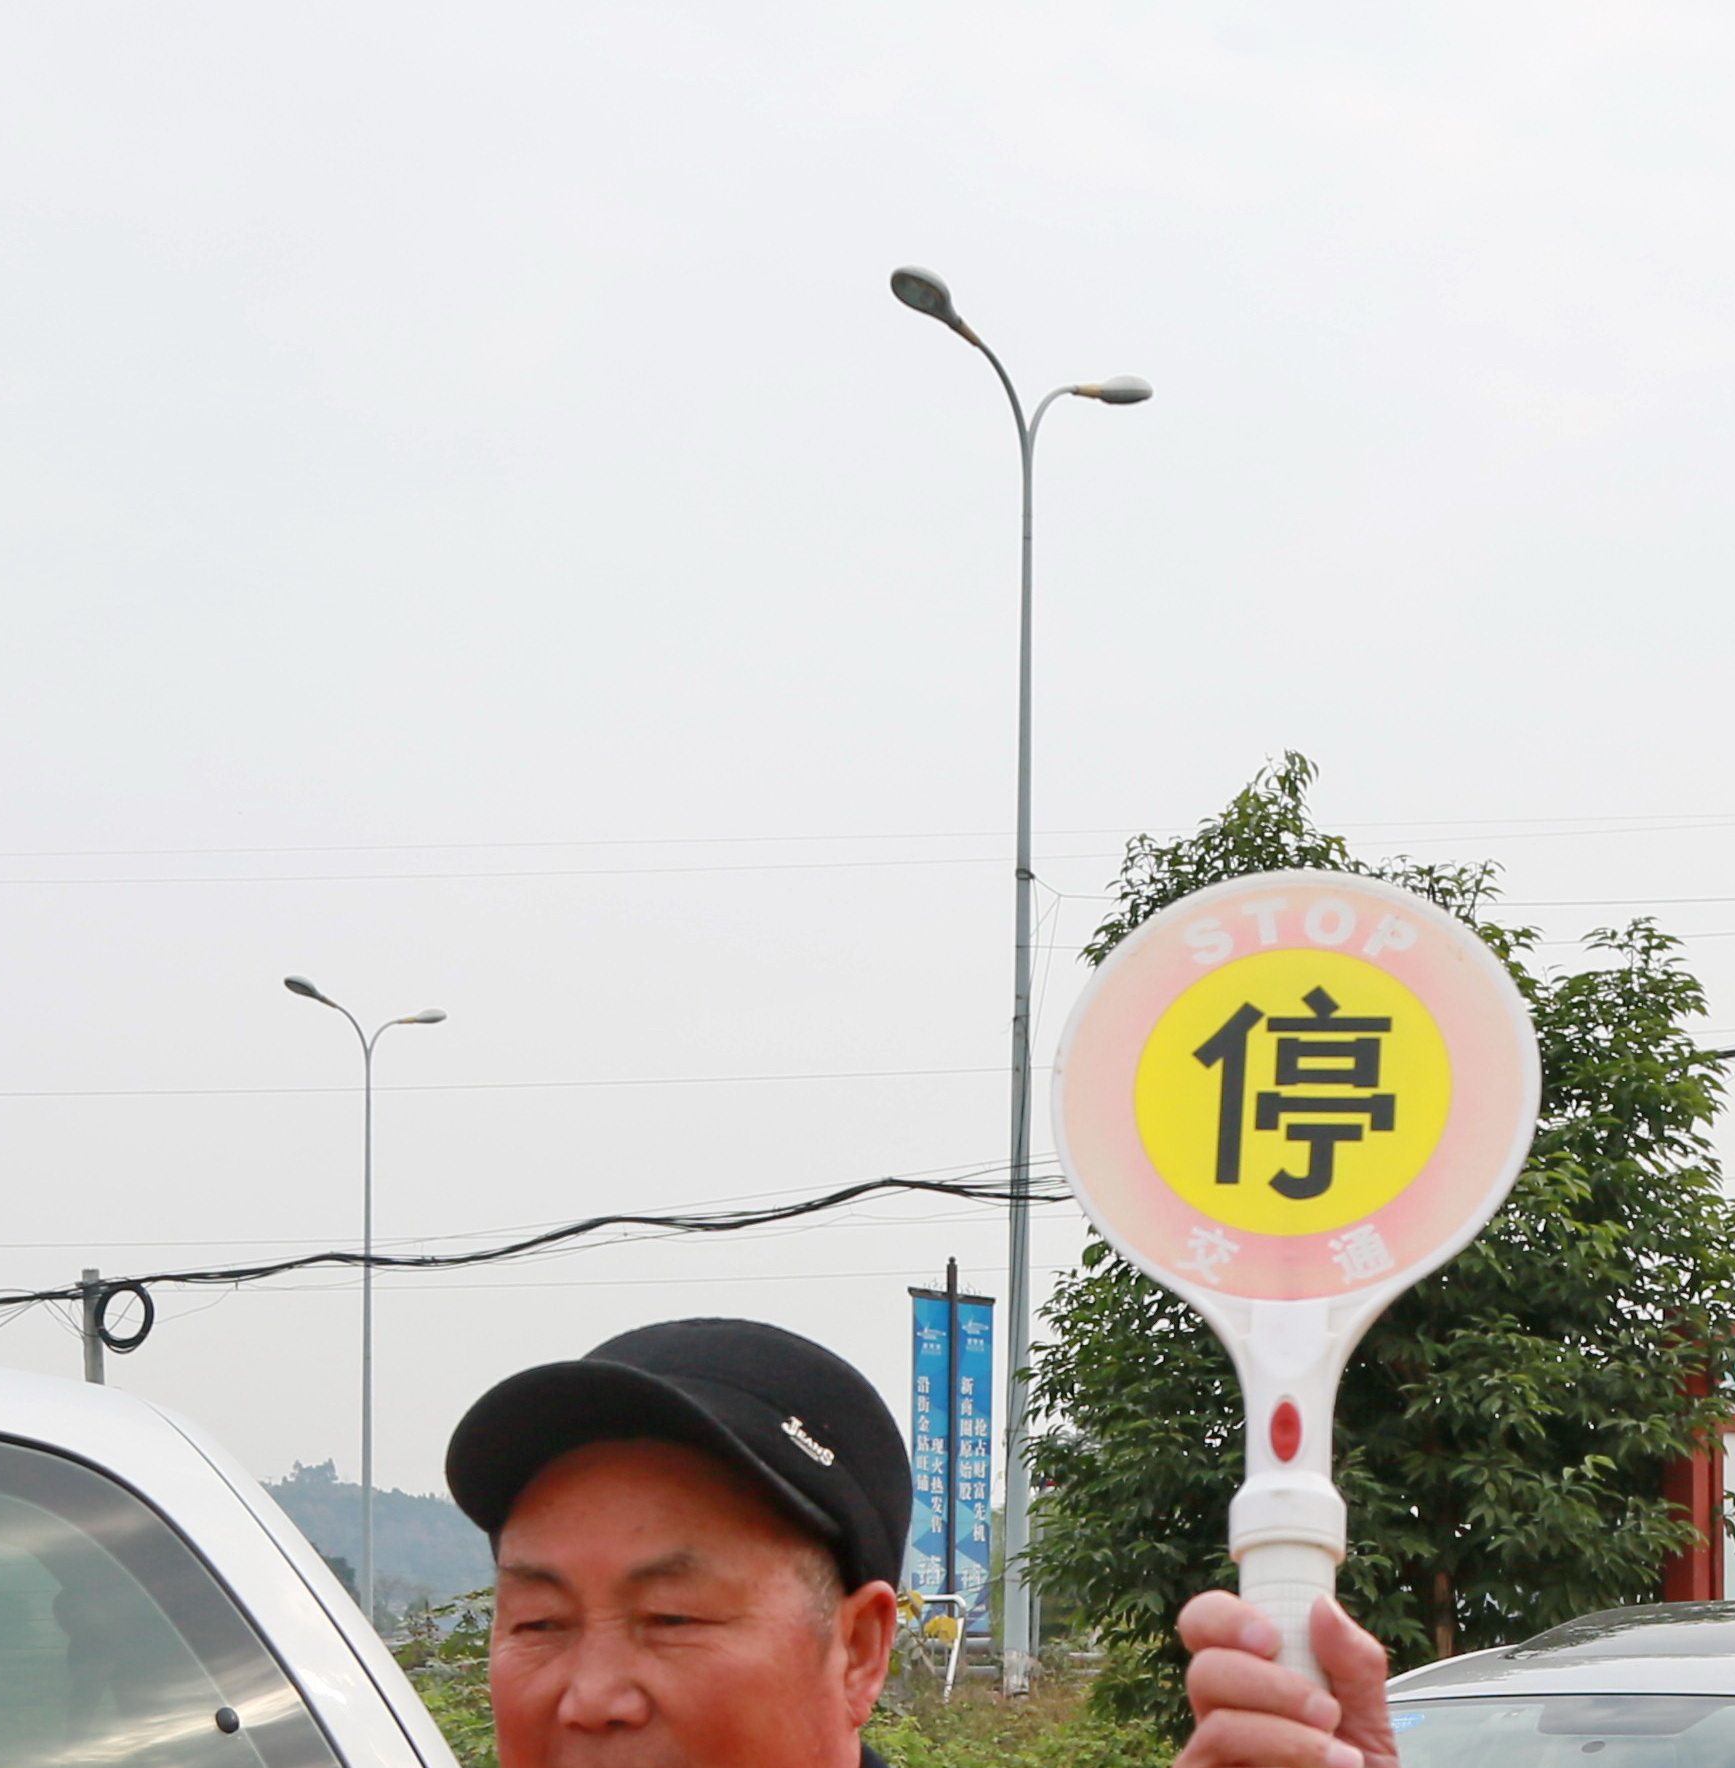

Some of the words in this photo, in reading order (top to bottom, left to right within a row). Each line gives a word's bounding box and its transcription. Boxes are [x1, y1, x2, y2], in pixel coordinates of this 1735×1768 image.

[1181, 899, 1418, 966] STOP
[1192, 985, 1397, 1200] 停
[972, 1417, 988, 1543] 抢占财富先机
